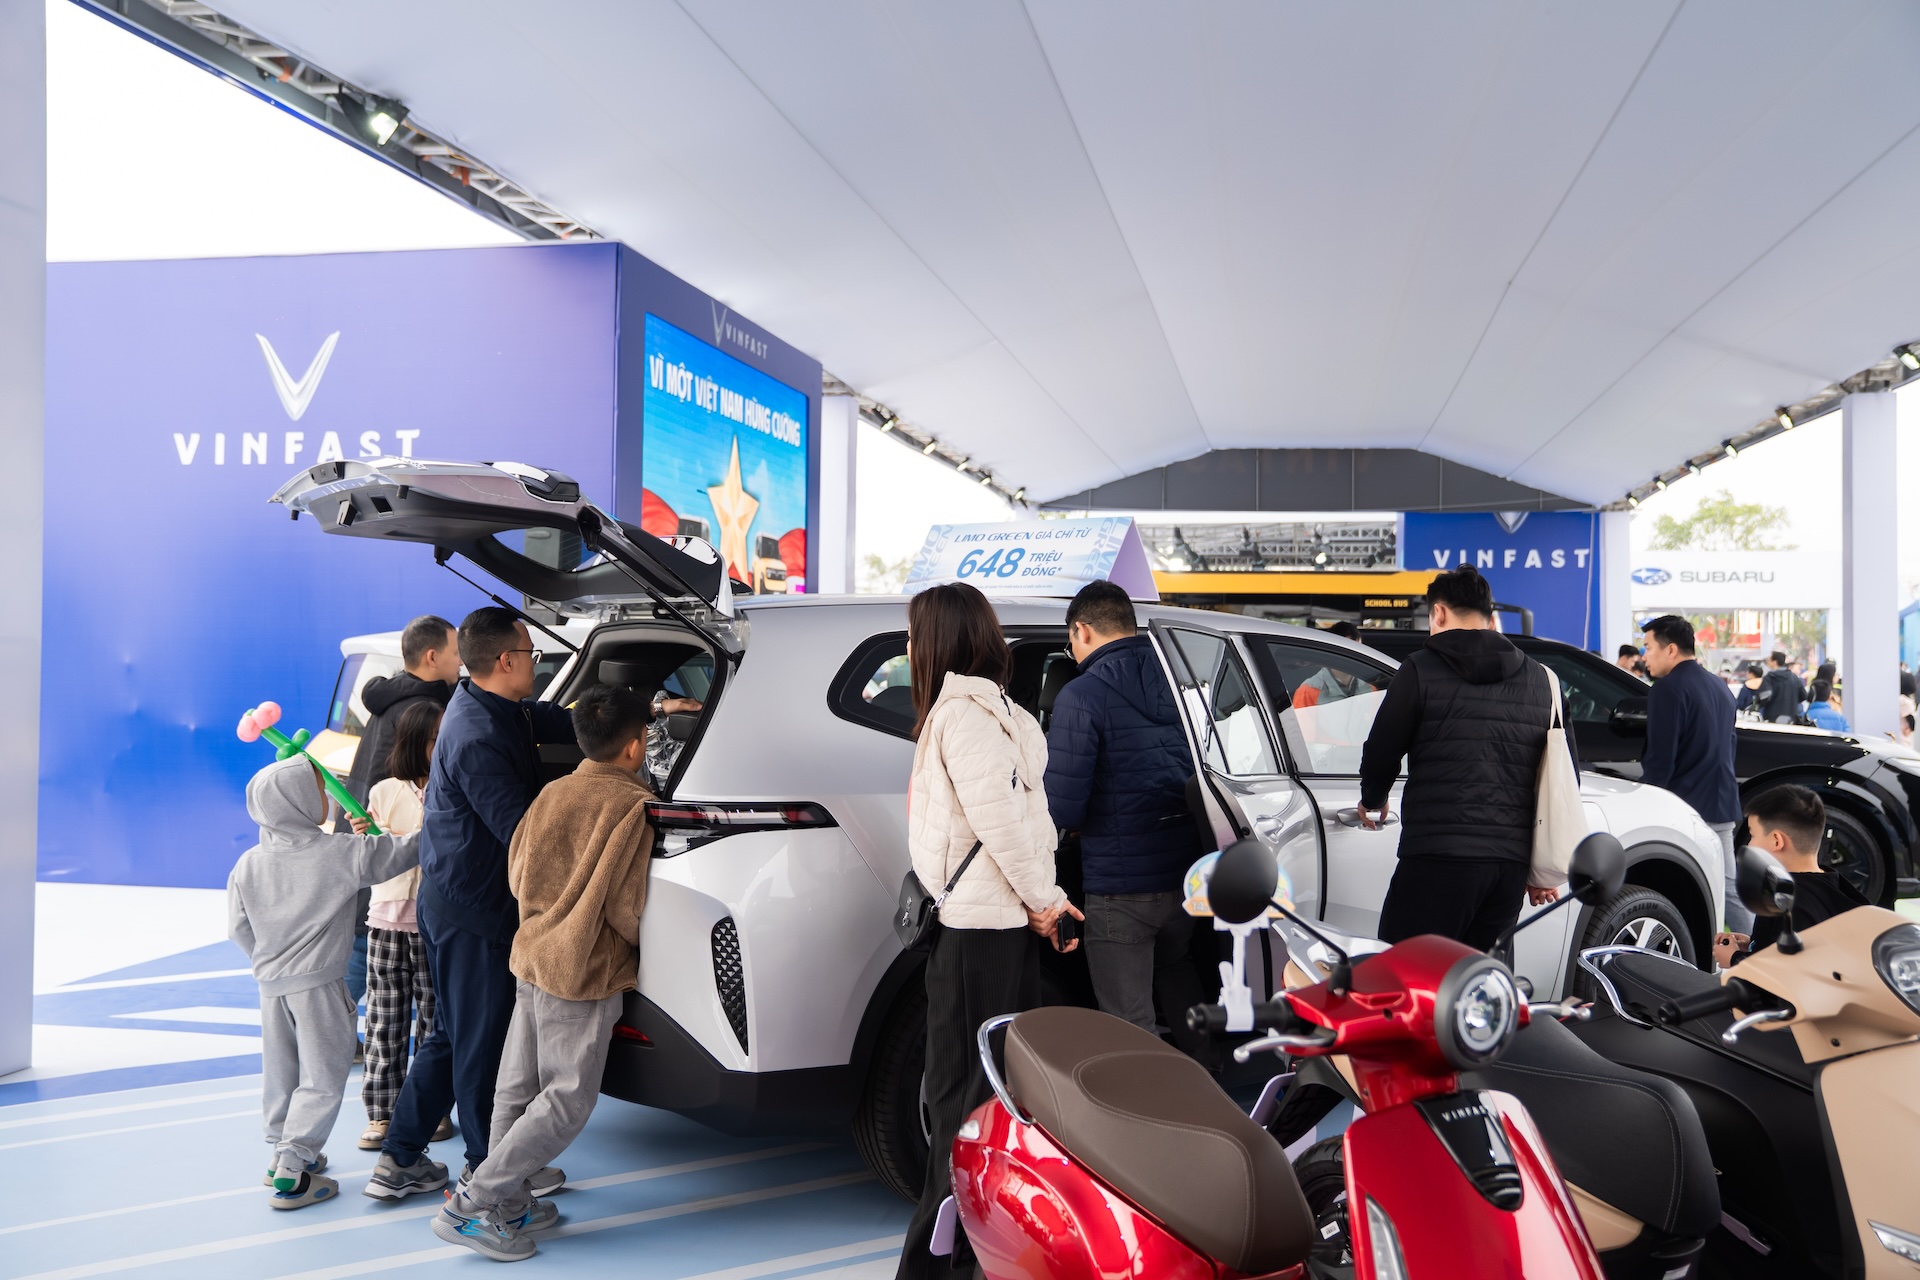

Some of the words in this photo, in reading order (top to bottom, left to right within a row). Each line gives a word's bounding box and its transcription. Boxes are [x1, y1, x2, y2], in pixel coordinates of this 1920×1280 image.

[725, 322, 768, 360] VINFAST
[649, 352, 664, 390] VÌ
[666, 362, 693, 404] MỘT
[694, 375, 718, 413] VIỆT
[720, 387, 744, 424] NAM
[745, 397, 771, 435] HÙNG
[173, 429, 420, 465] VINFAST
[954, 533, 986, 543] LIMO
[987, 531, 1034, 541] GREEN
[1035, 528, 1053, 539] GIÁ
[1055, 527, 1075, 539] CHỈ
[1076, 527, 1092, 538] TỪ
[956, 547, 1026, 579] 648
[1029, 549, 1063, 564] TRIỆU
[1433, 549, 1589, 569] VINFAST
[1679, 571, 1774, 583] SUBARU
[1364, 599, 1392, 608] SCHOOL
[1393, 599, 1408, 608] BUS
[1626, 902, 1659, 916] SAILUN
